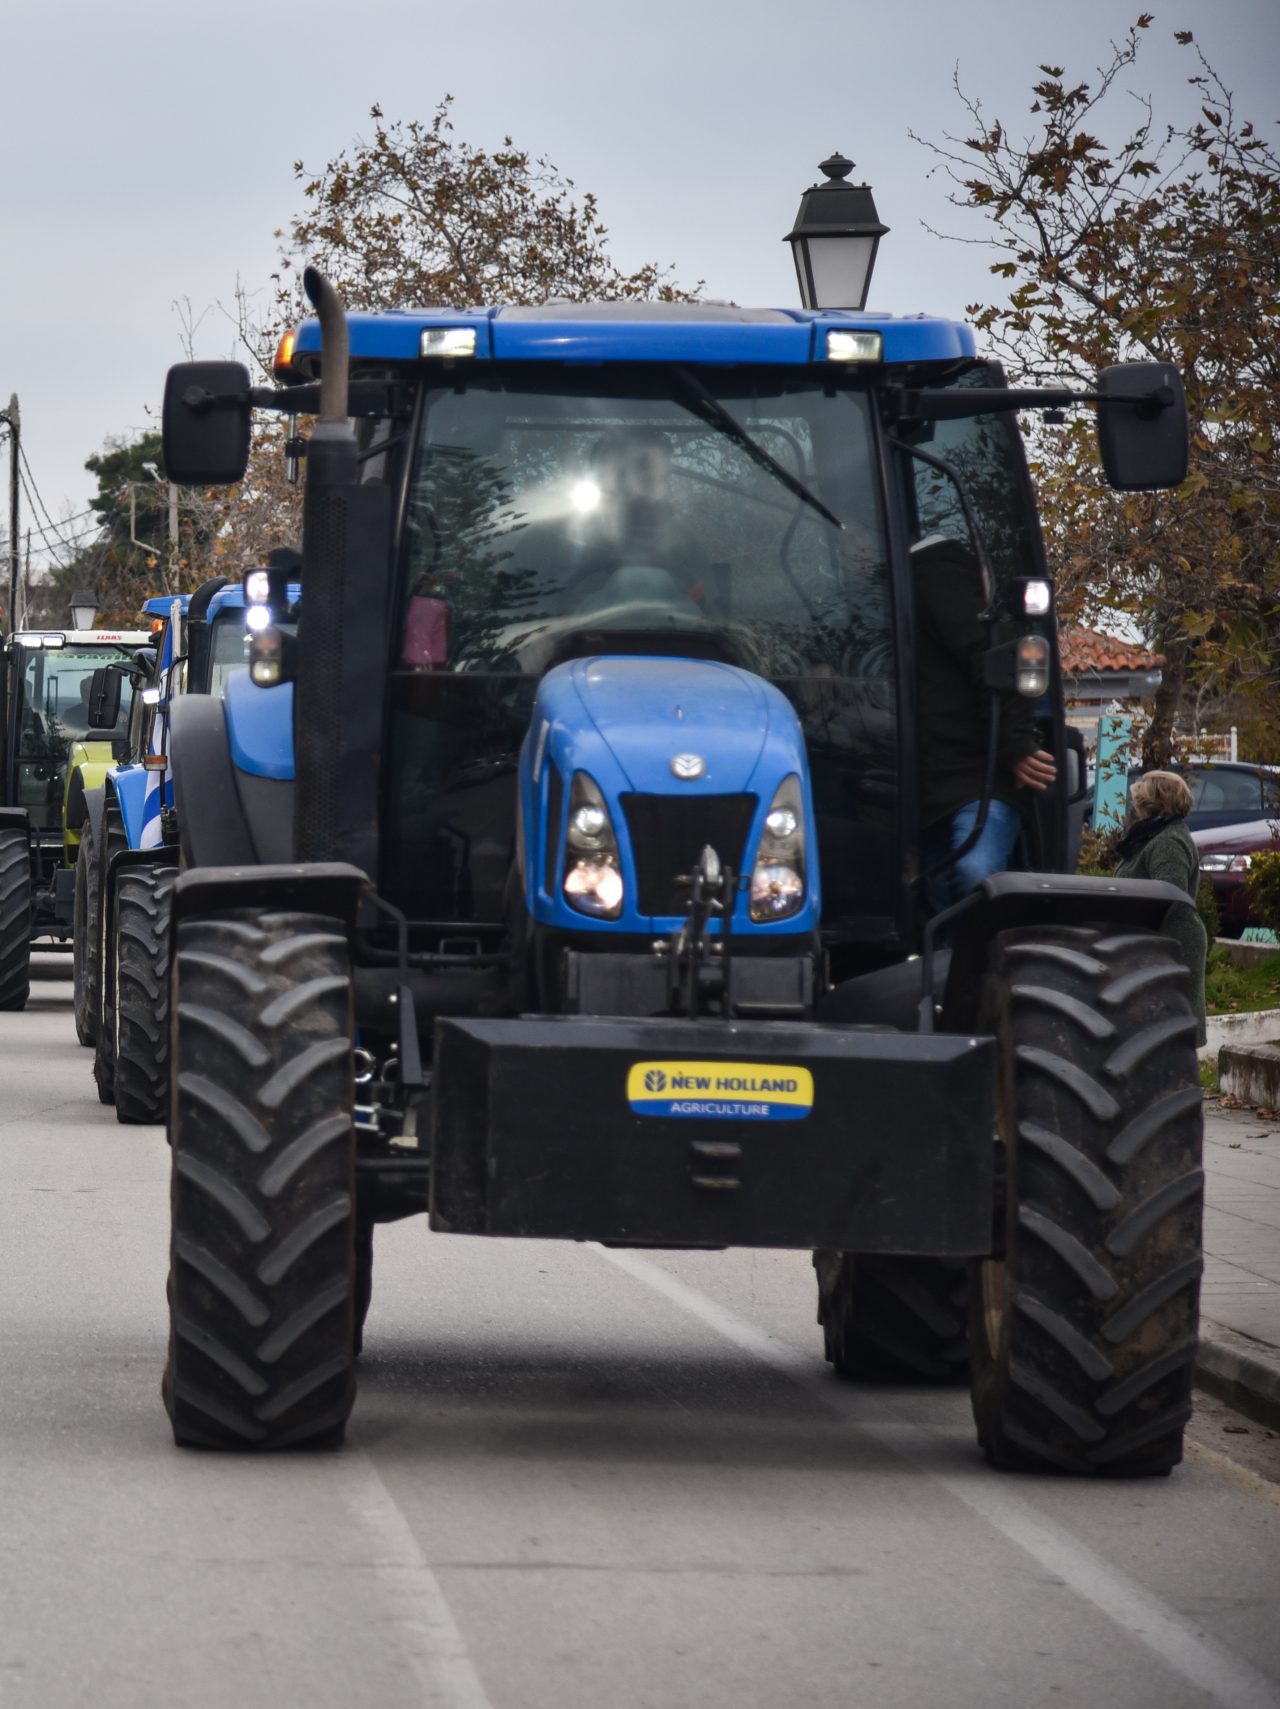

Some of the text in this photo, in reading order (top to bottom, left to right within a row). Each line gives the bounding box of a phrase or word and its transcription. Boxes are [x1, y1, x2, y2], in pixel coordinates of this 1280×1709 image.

[671, 1076, 798, 1093] NEW HOLLAND
[671, 1102, 769, 1115] AGRICULTURE
